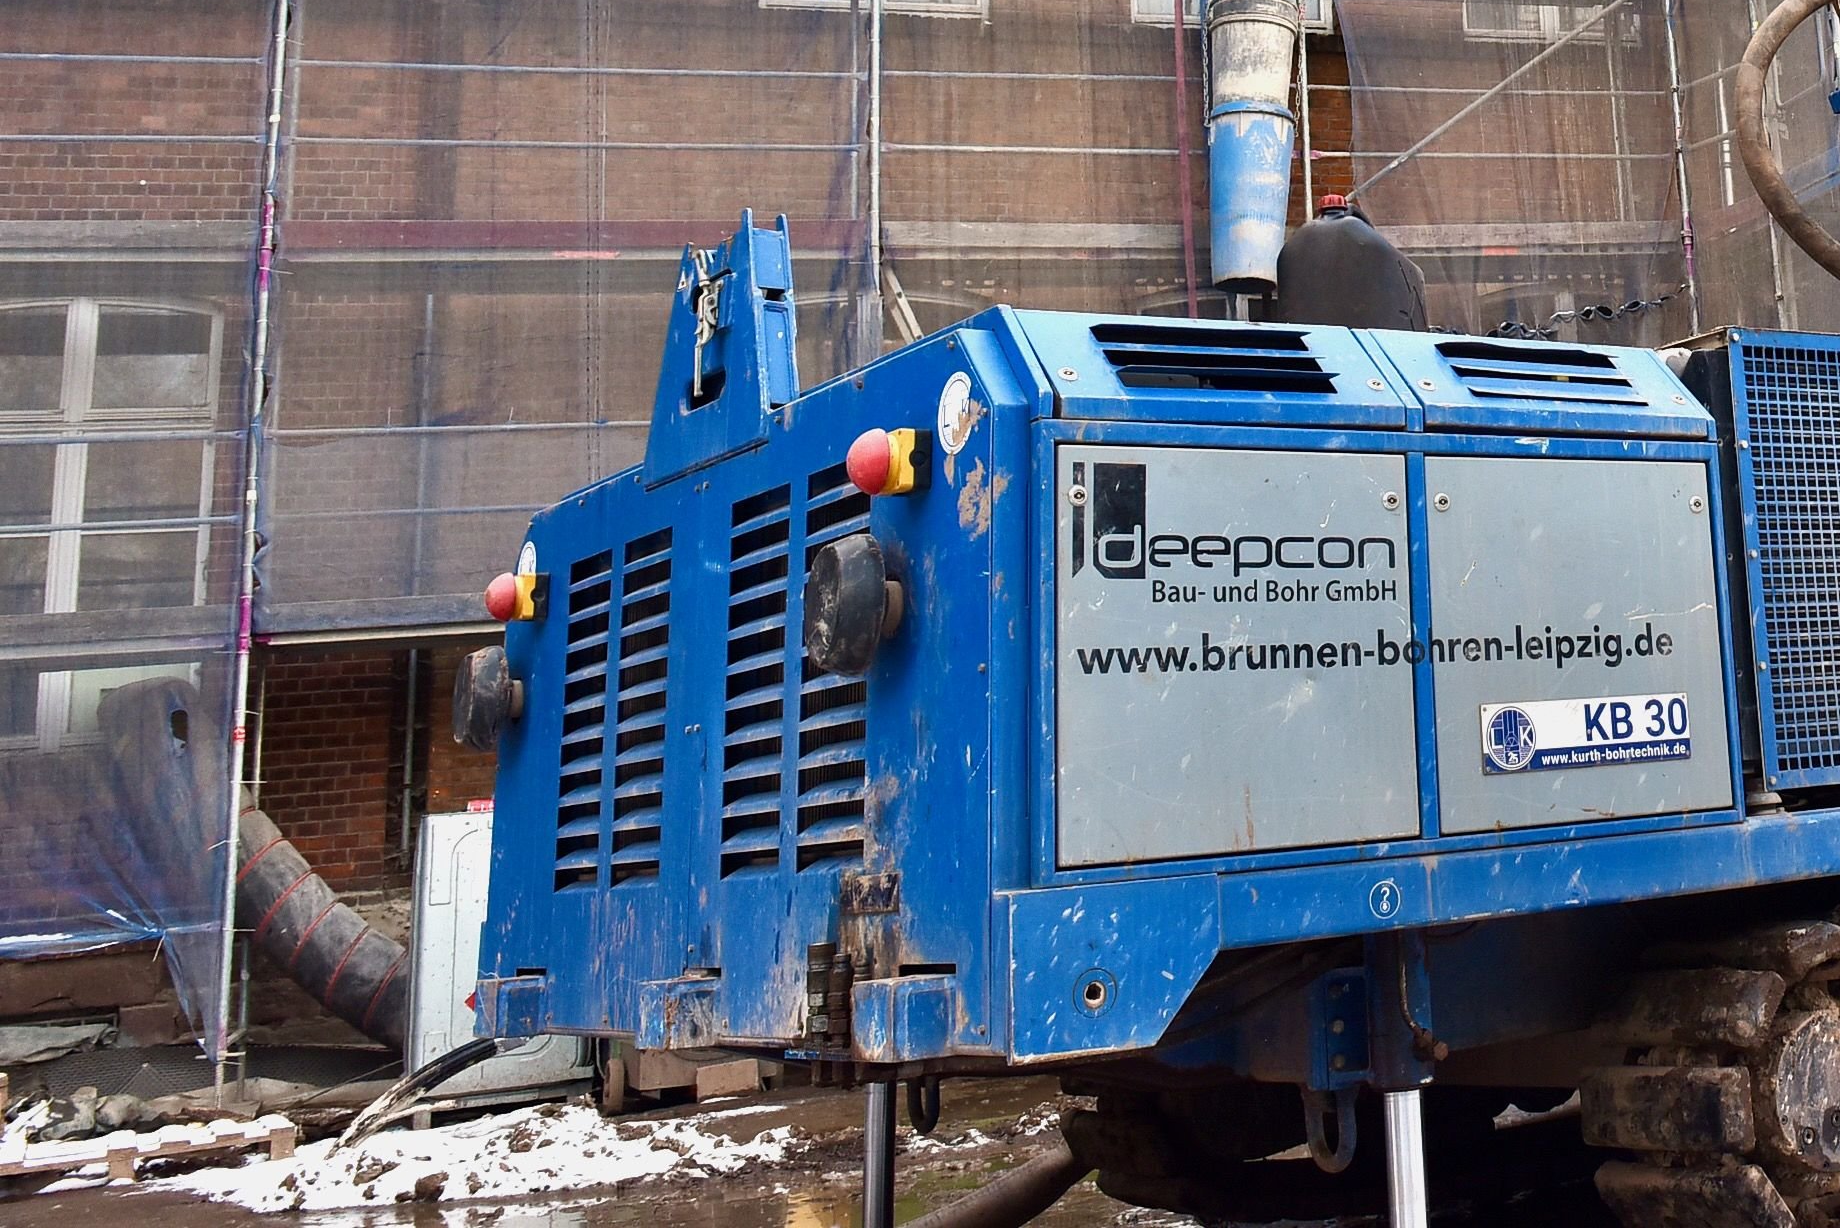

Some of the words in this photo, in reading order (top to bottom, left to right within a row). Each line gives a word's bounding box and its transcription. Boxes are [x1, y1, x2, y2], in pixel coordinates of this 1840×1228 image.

[1097, 523, 1396, 577] deepcon
[1151, 579, 1206, 603] Bau-
[1213, 579, 1259, 603] und
[1265, 579, 1320, 603] Bohr
[1325, 579, 1397, 603] GmbH
[1076, 622, 1674, 675] www.brunnen-bohren-leipzig.de
[1584, 702, 1634, 742] KB
[1644, 697, 1688, 738] 30
[1541, 741, 1687, 766] www.kurth-bohrtechnik.de
